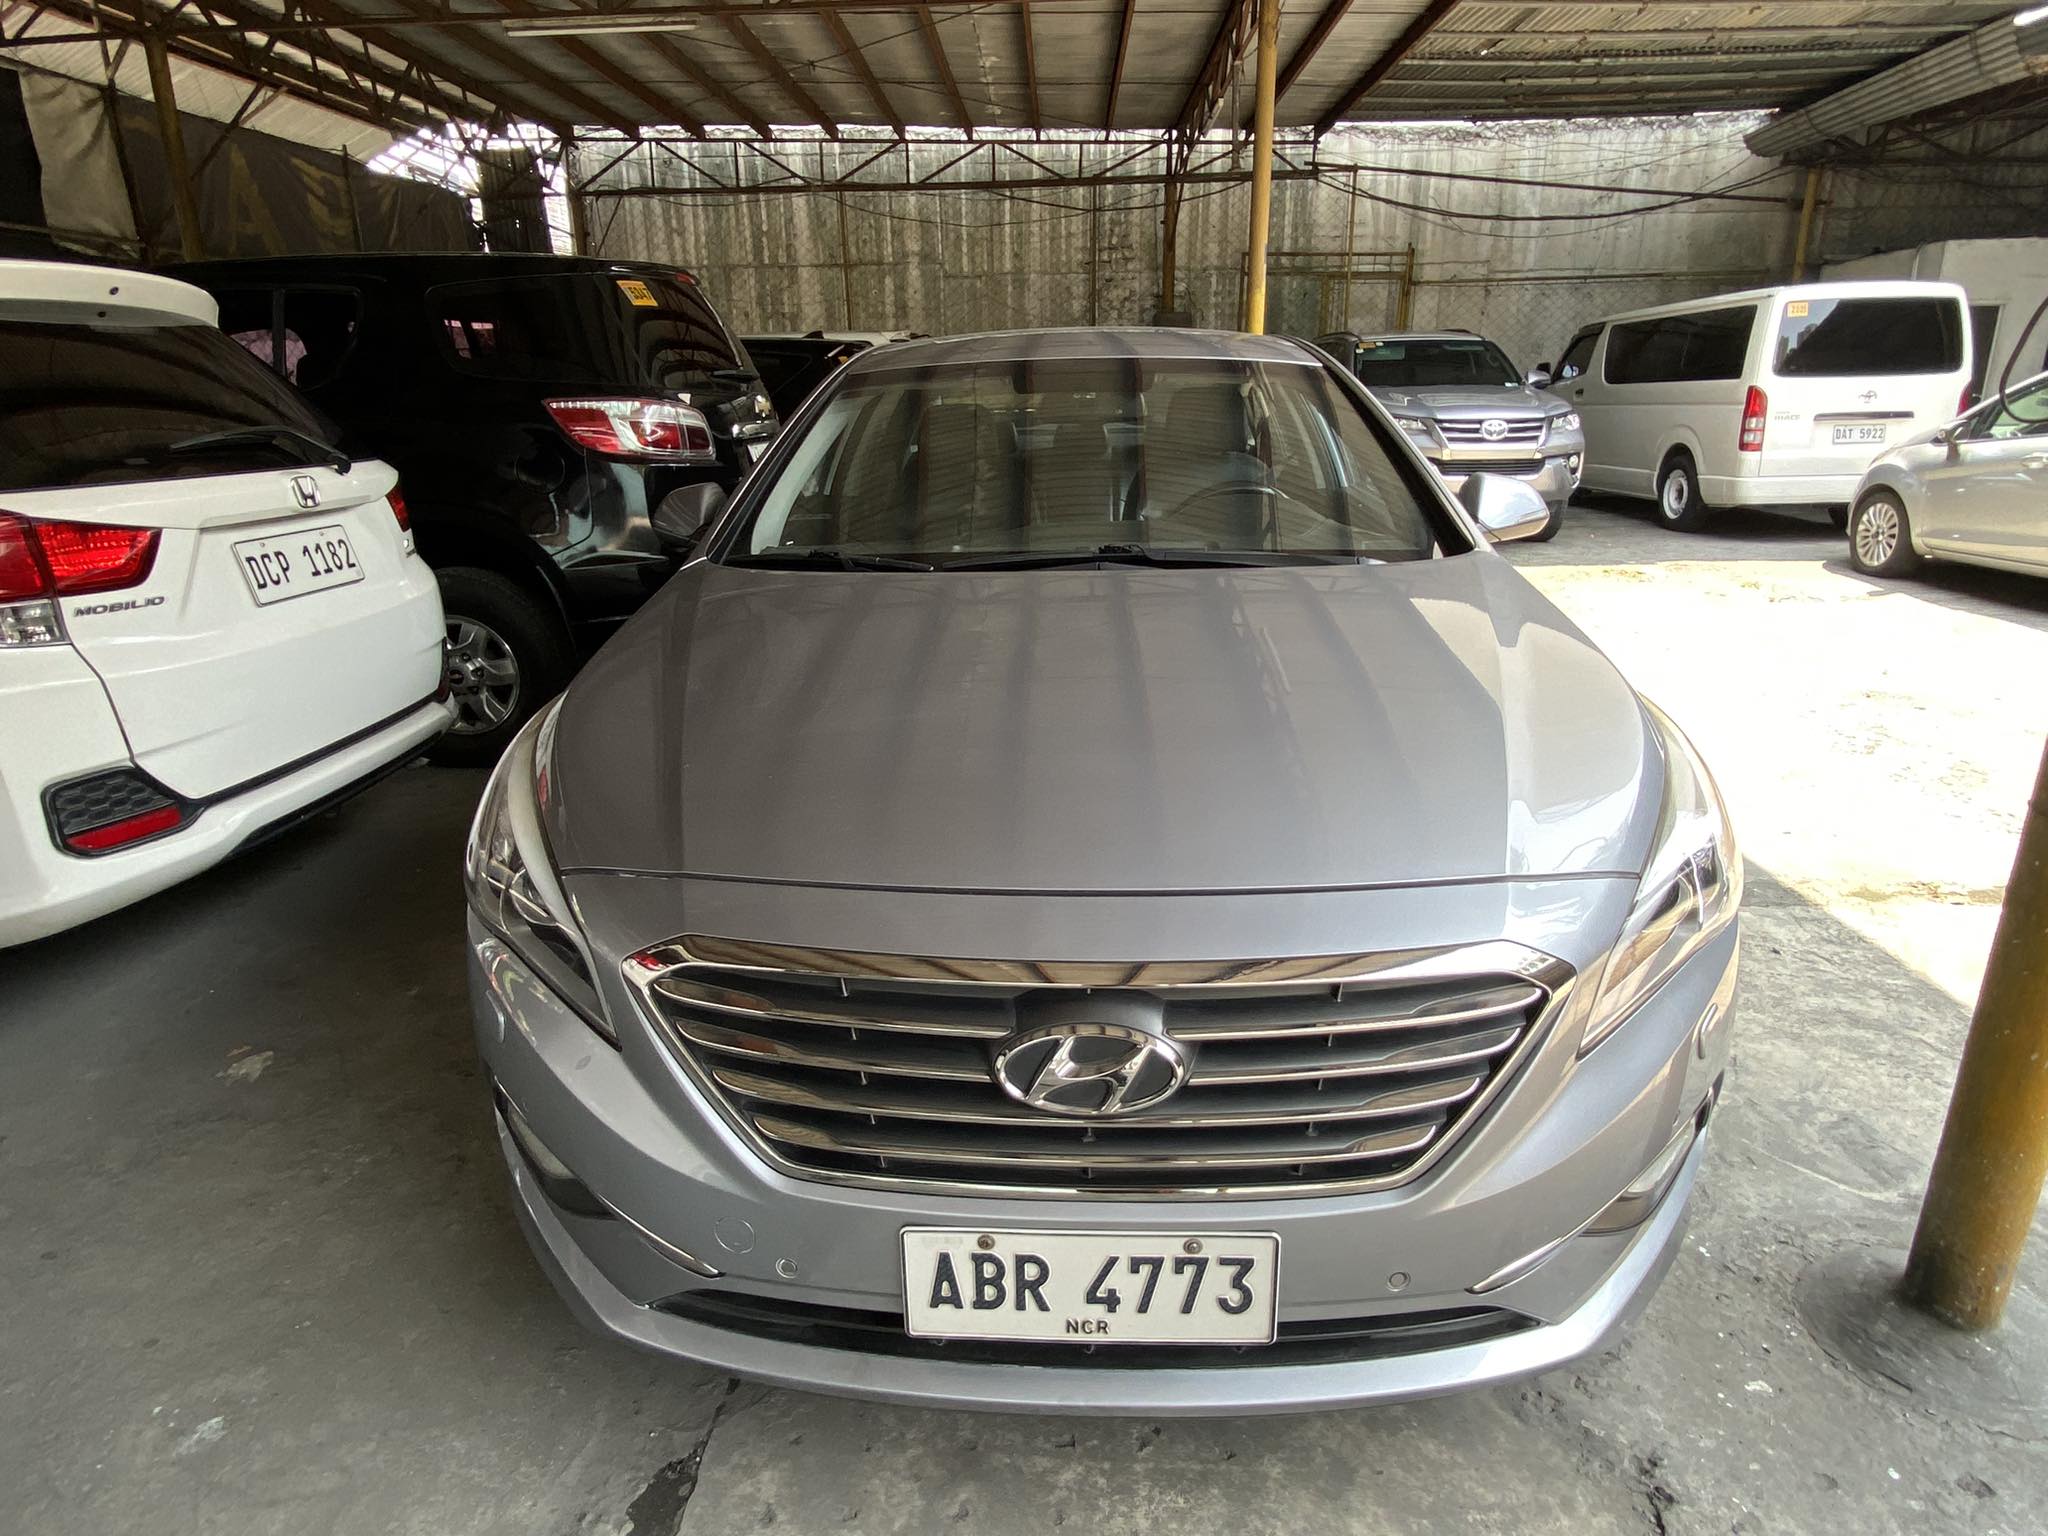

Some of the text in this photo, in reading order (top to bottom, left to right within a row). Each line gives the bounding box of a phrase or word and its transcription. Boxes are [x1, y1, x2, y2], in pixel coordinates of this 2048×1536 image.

[1835, 427, 1885, 440] DAT 5922
[245, 538, 356, 590] DCP 1182
[74, 596, 165, 616] MOBILIO
[929, 1250, 1256, 1315] ABR 4773
[1065, 1318, 1110, 1335] NCR
